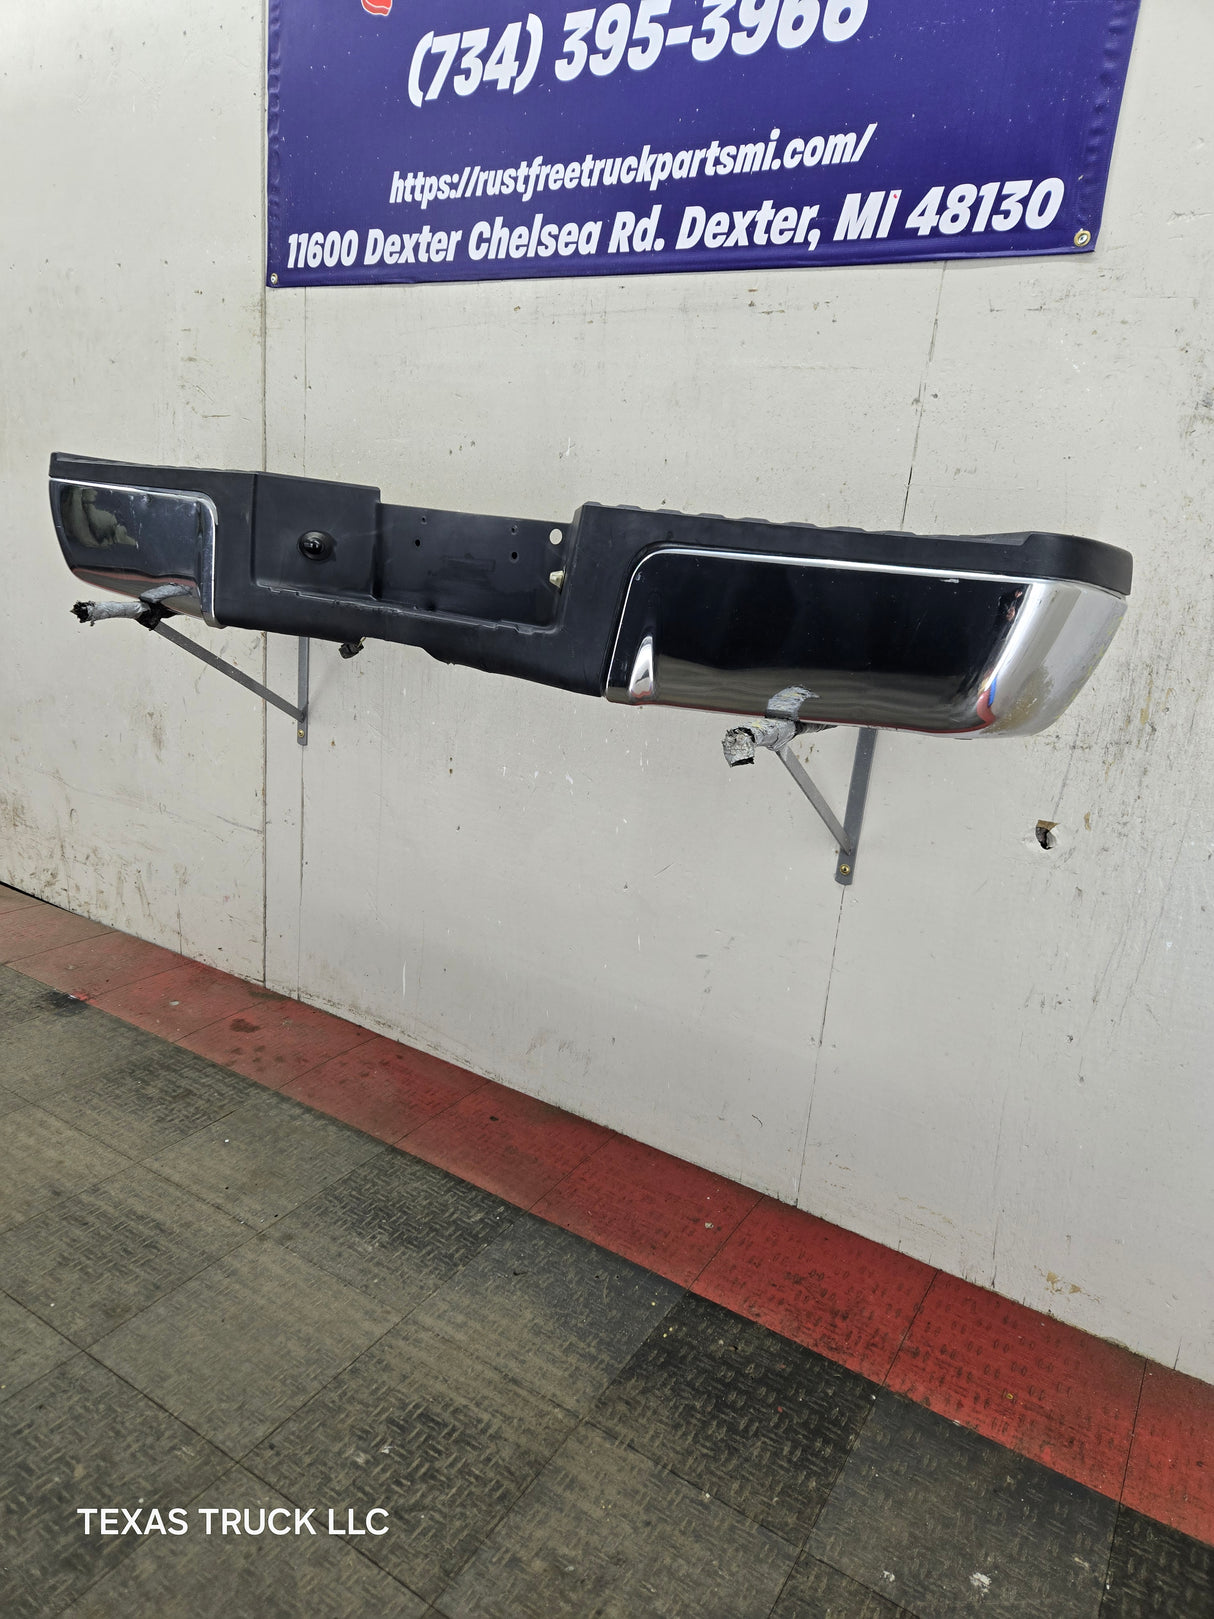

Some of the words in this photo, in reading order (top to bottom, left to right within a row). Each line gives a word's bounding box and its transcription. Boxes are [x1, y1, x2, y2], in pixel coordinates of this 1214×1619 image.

[408, 13, 544, 108] (734)
[390, 123, 878, 210] https://rustfreetruckpartsmi.com/
[287, 229, 358, 268] 11600
[364, 225, 462, 265] Dexter
[469, 214, 602, 261] Chelsea
[608, 205, 665, 254] Rd.
[675, 200, 820, 252] Dexter,
[833, 189, 902, 241] MI
[904, 177, 1065, 236] 48130
